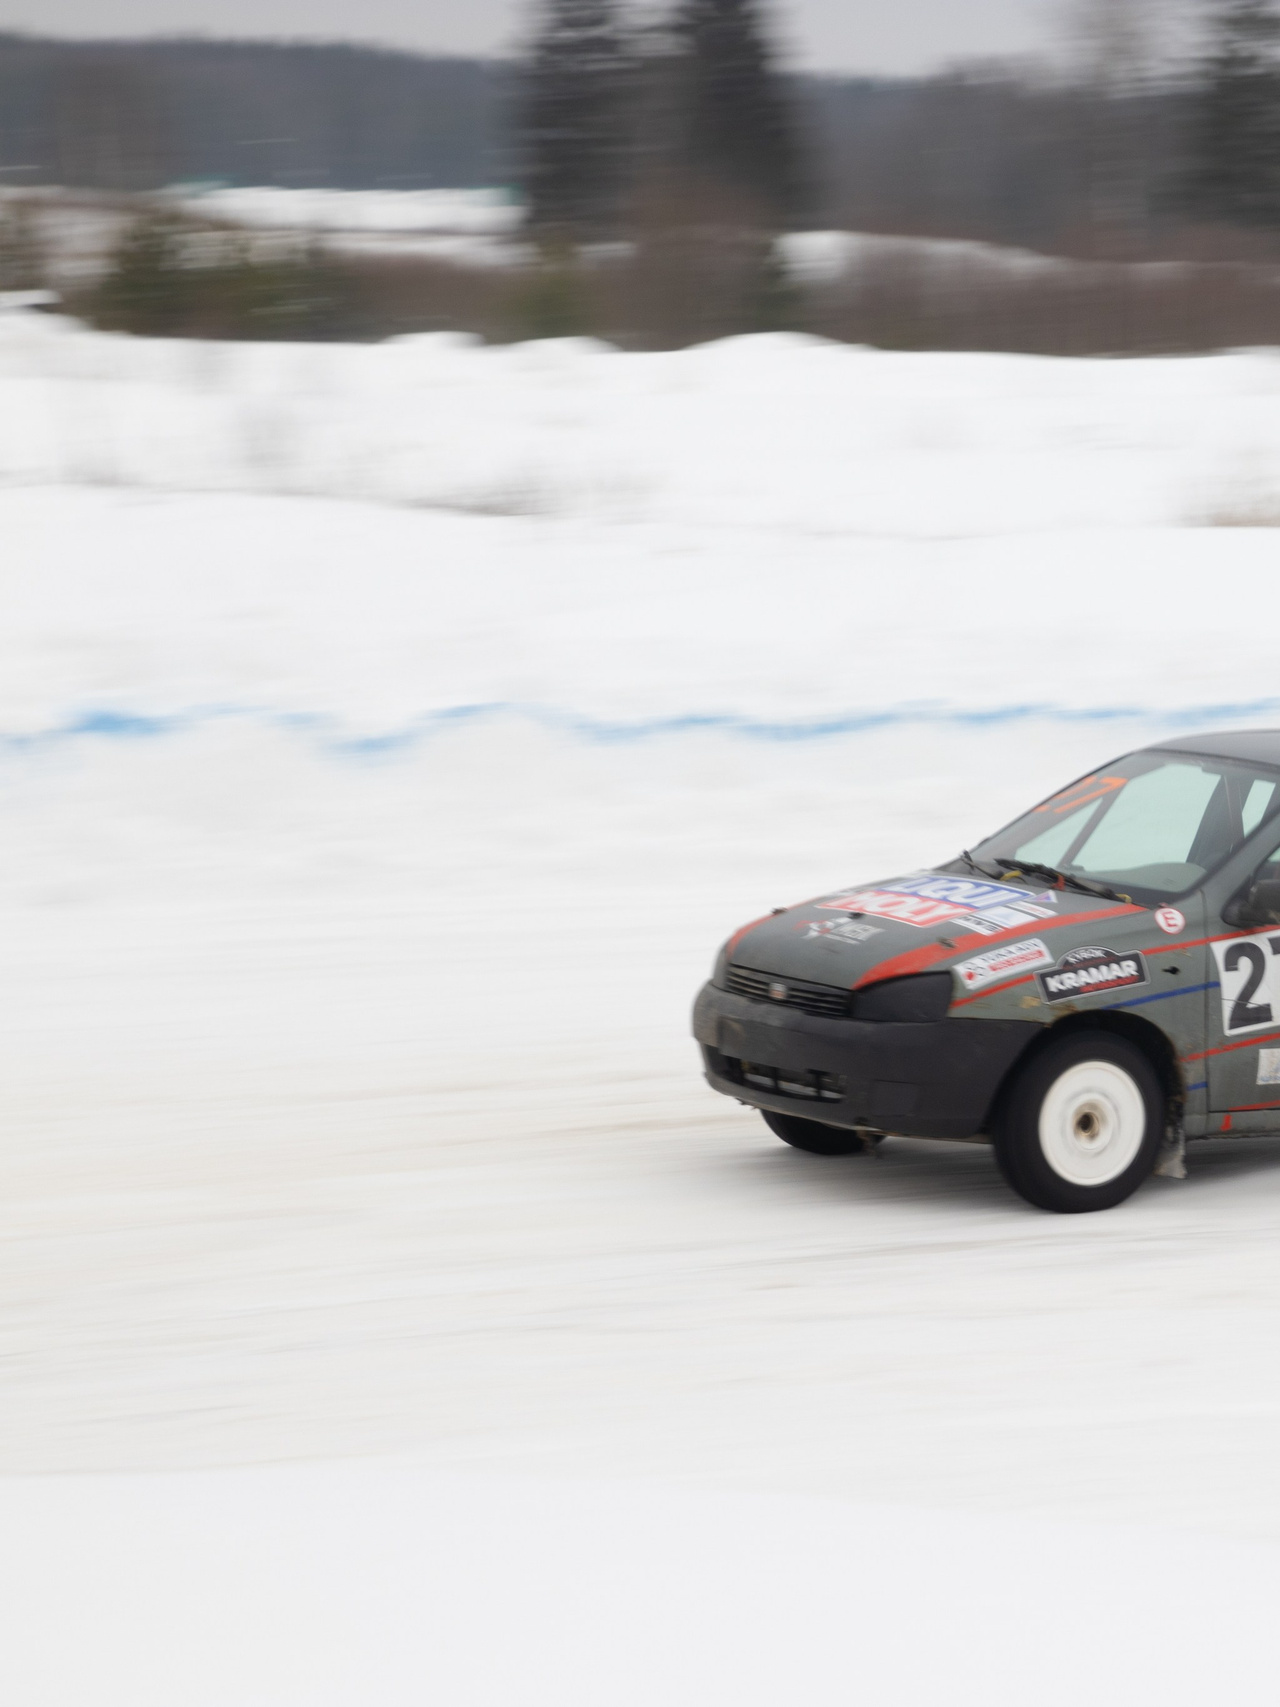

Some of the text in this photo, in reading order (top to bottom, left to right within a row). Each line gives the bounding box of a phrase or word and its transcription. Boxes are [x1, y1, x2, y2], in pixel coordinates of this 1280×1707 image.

[826, 890, 970, 924] MOLY
[1161, 911, 1178, 927] E
[1045, 959, 1139, 993] KRAMAR
